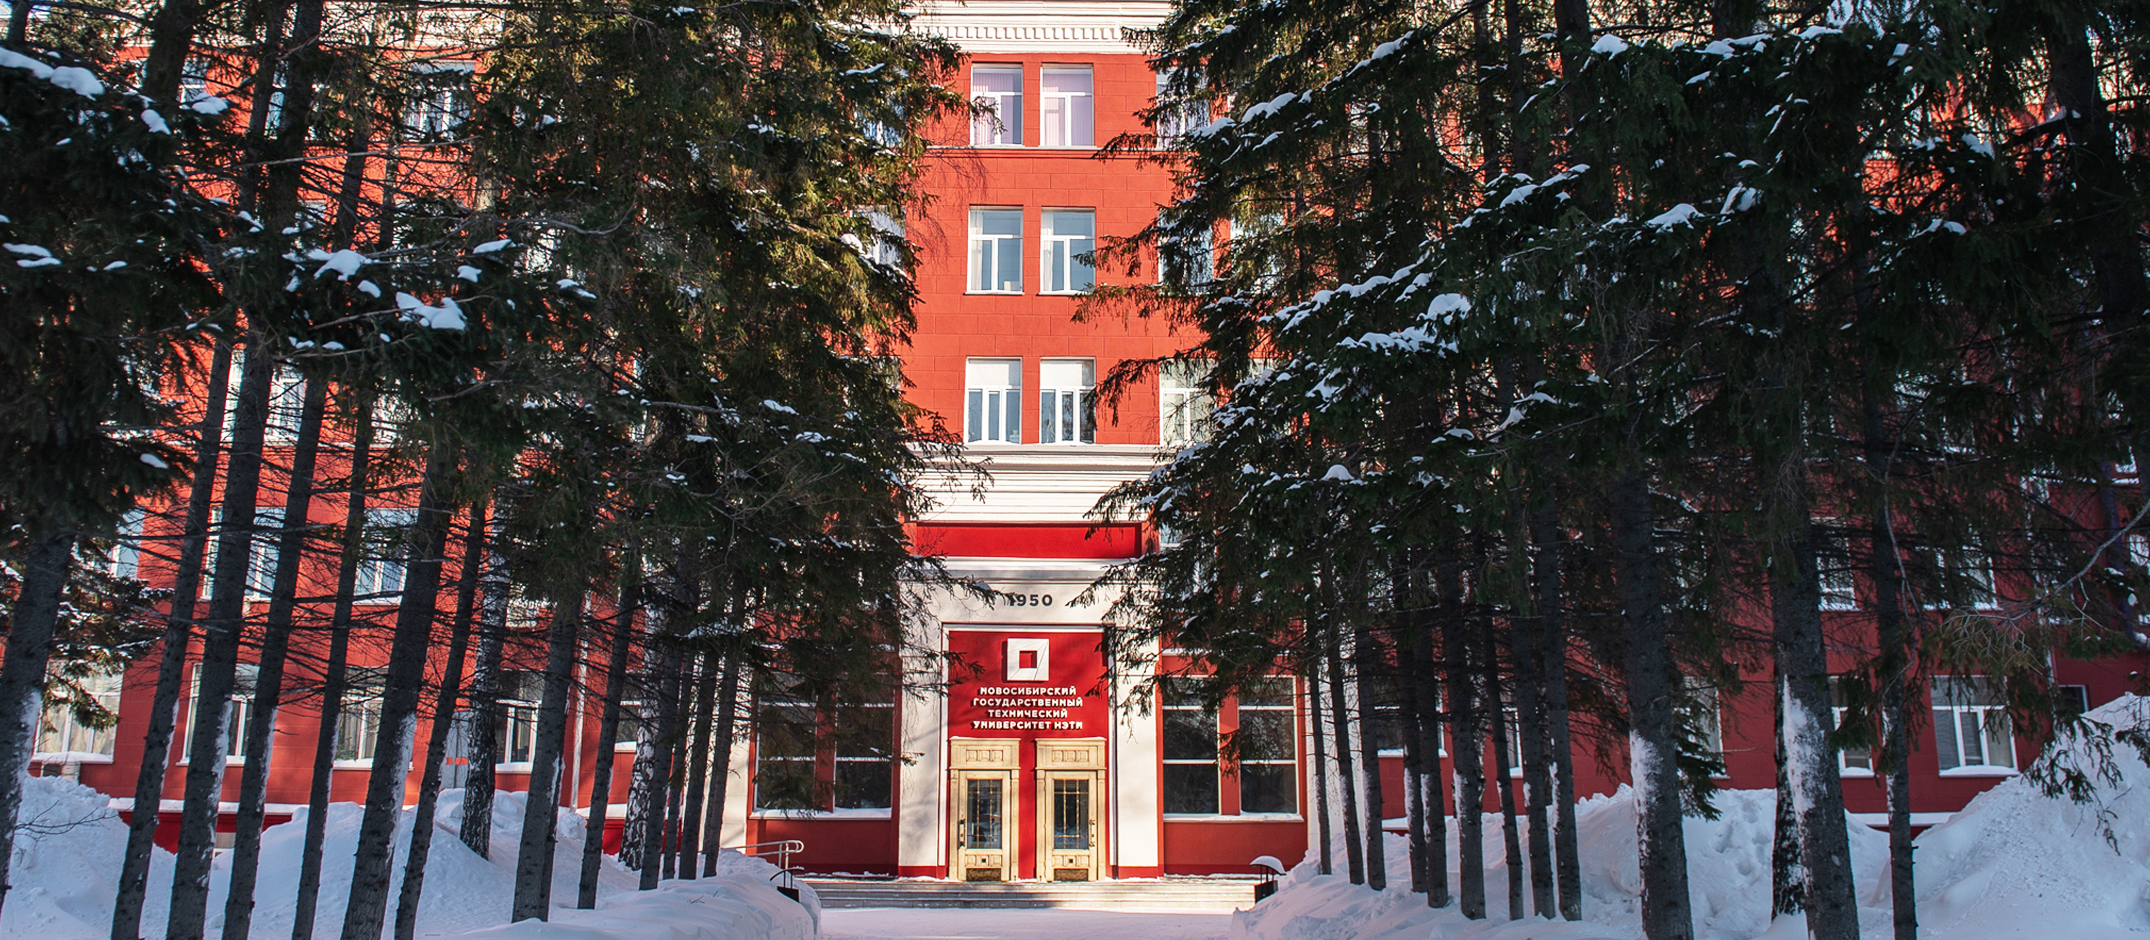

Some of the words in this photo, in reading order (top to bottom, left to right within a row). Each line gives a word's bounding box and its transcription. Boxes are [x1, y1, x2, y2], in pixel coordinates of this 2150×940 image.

[980, 686, 1077, 696] НОВОСИБИРСКИЙ
[973, 697, 1083, 707] ГОСУДАРСТВЕННЫЙ
[988, 708, 1068, 718] ТЕХНИЧЕСКИЙ
[973, 720, 1052, 729] УНИВЕРСИТЕТ
[1054, 720, 1083, 729] НЭТИ
